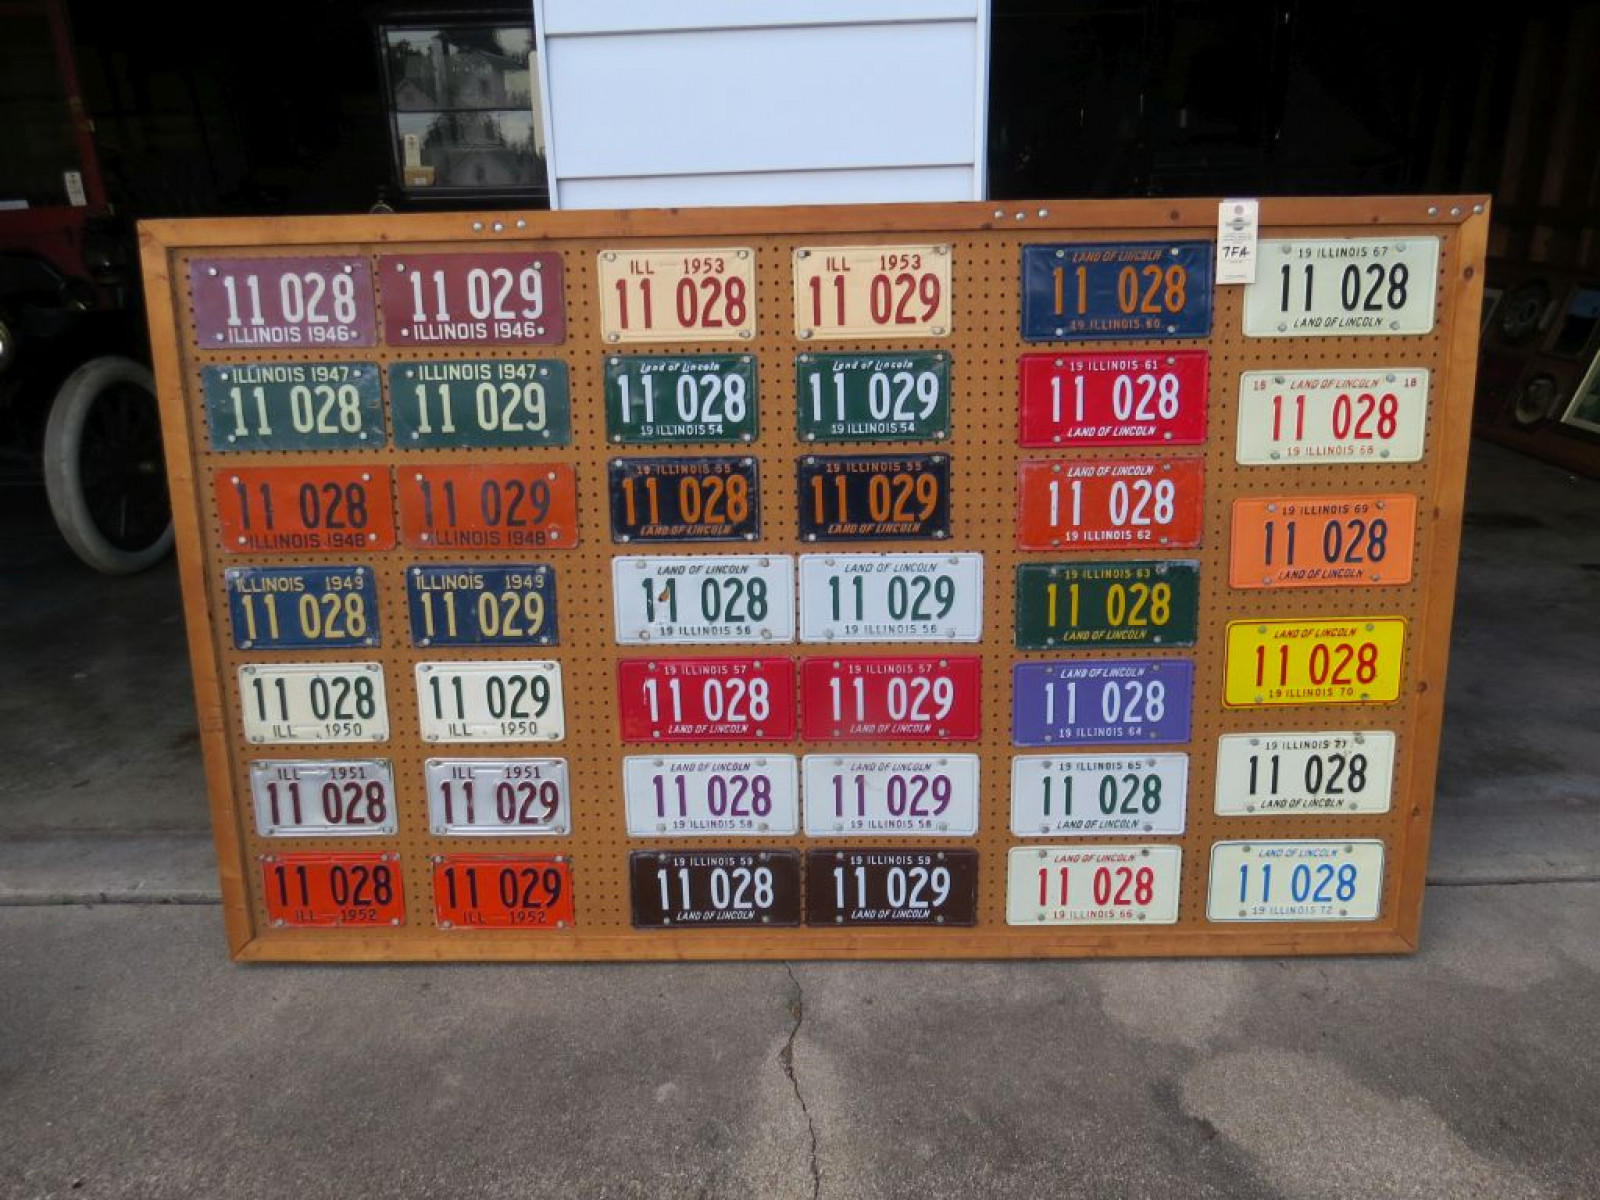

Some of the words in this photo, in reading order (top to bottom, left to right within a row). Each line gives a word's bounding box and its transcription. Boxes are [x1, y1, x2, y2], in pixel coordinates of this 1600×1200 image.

[630, 260, 654, 275] ILL
[683, 258, 725, 274] 1953
[826, 257, 850, 272] ILL
[880, 255, 921, 270] 1953
[1299, 248, 1311, 258] 19
[1317, 247, 1367, 258] ILLINOIS
[1373, 247, 1388, 257] 67
[223, 275, 265, 326] 11
[280, 272, 357, 324] 028
[410, 271, 450, 322] 11
[467, 268, 543, 320] 029
[616, 278, 652, 329] 11
[676, 277, 746, 327] 028
[810, 274, 845, 326] 11
[870, 273, 940, 324] 029
[1053, 266, 1087, 316] 11
[1118, 266, 1187, 314] 028
[1281, 264, 1313, 312] 11
[1341, 263, 1409, 311] 028
[228, 328, 301, 343] ILLINOIS
[308, 326, 349, 342] 1946
[414, 324, 487, 339] ILLINOIS
[494, 322, 535, 338] 1946
[1294, 317, 1322, 328] LAND
[1324, 317, 1337, 328] OF
[1338, 316, 1383, 327] LINCOLN
[232, 368, 305, 383] ILLINOIS
[311, 367, 349, 381] 1947
[418, 365, 491, 380] ILLINOIS
[499, 364, 536, 379] 1947
[1070, 362, 1083, 371] 19
[1089, 361, 1138, 371] ILLINOIS
[1145, 360, 1157, 370] 61
[231, 387, 272, 436] 11
[290, 385, 362, 434] 028
[415, 384, 455, 433] 11
[476, 382, 546, 432] 029
[617, 374, 654, 423] 11
[676, 374, 746, 423] 028
[810, 373, 845, 421] 11
[868, 372, 939, 421] 029
[1051, 375, 1084, 422] 11
[1113, 374, 1179, 420] 028
[1273, 394, 1306, 441] 11
[1333, 394, 1398, 440] 028
[641, 426, 653, 435] 19
[656, 425, 705, 435] ILLINOIS
[708, 424, 723, 434] 54
[1068, 427, 1095, 437] LAND
[1098, 427, 1110, 436] OF
[1114, 425, 1156, 436] LINCOLN
[1067, 467, 1094, 477] LAND
[1097, 467, 1109, 476] OF
[1112, 466, 1153, 475] LINCOLN
[236, 482, 274, 529] 11
[301, 482, 368, 529] 028
[421, 479, 456, 527] 11
[481, 479, 551, 526] 029
[622, 478, 659, 526] 11
[679, 474, 748, 524] 028
[812, 475, 848, 524] 11
[869, 474, 938, 522] 029
[1050, 481, 1082, 526] 11
[1109, 480, 1175, 525] 028
[1066, 532, 1078, 540] 19
[1084, 531, 1131, 540] ILLINOIS
[1137, 531, 1150, 539] 62
[1265, 521, 1296, 565] 11
[1323, 519, 1388, 563] 028
[236, 577, 305, 592] ILLINOIS
[325, 576, 364, 589] 1949
[417, 576, 484, 590] ILLINOIS
[505, 575, 544, 589] 1949
[844, 563, 873, 572] LAND
[876, 562, 889, 572] OF
[892, 562, 937, 572] LINCOLN
[242, 594, 278, 639] 11
[300, 593, 366, 639] 028
[421, 592, 457, 636] 11
[478, 592, 544, 637] 029
[642, 578, 677, 623] 11
[701, 577, 768, 622] 028
[829, 576, 863, 621] 11
[888, 575, 955, 621] 029
[1048, 583, 1078, 627] 11
[1107, 583, 1171, 626] 028
[681, 666, 729, 675] ILLINOIS
[1256, 645, 1288, 686] 11
[1309, 642, 1377, 685] 028
[253, 677, 288, 720] 11
[310, 675, 376, 720] 028
[430, 675, 465, 719] 11
[486, 675, 550, 719] 029
[646, 679, 682, 722] 11
[704, 678, 769, 722] 028
[831, 678, 864, 721] 11
[888, 678, 954, 721] 029
[1045, 682, 1076, 724] 11
[1102, 680, 1165, 723] 028
[273, 725, 297, 738] ILL
[325, 723, 362, 737] 1950
[450, 723, 472, 736] ILL
[501, 722, 537, 735] 1950
[1059, 728, 1071, 737] 19
[1077, 727, 1122, 737] ILLINOIS
[1128, 727, 1141, 736] 64
[278, 767, 301, 780] ILL
[330, 767, 367, 779] 1951
[452, 767, 475, 779] ILL
[505, 767, 541, 779] 1951
[1077, 762, 1122, 770] ILLINOIS
[1250, 755, 1279, 795] 11
[1305, 754, 1367, 794] 028
[267, 782, 302, 826] 11
[322, 781, 386, 824] 028
[440, 781, 474, 824] 11
[496, 780, 559, 824] 029
[652, 775, 687, 818] 11
[708, 774, 772, 817] 028
[832, 775, 865, 817] 11
[887, 774, 951, 817] 029
[1043, 776, 1072, 816] 11
[1100, 774, 1161, 815] 028
[275, 866, 309, 906] 11
[330, 866, 393, 906] 028
[445, 868, 478, 909] 11
[500, 868, 561, 909] 029
[658, 869, 690, 910] 11
[710, 868, 774, 909] 028
[834, 867, 866, 909] 11
[887, 866, 950, 909] 029
[1039, 867, 1068, 906] 11
[1094, 867, 1154, 905] 028
[1240, 864, 1271, 903] 11
[1292, 864, 1357, 902] 028
[294, 910, 316, 922] ILL
[341, 909, 377, 921] 1952
[463, 912, 485, 923] ILL
[510, 911, 545, 923] 1952
[851, 910, 875, 919] LAND
[878, 910, 889, 918] OF
[892, 909, 930, 918] LINCOLN
